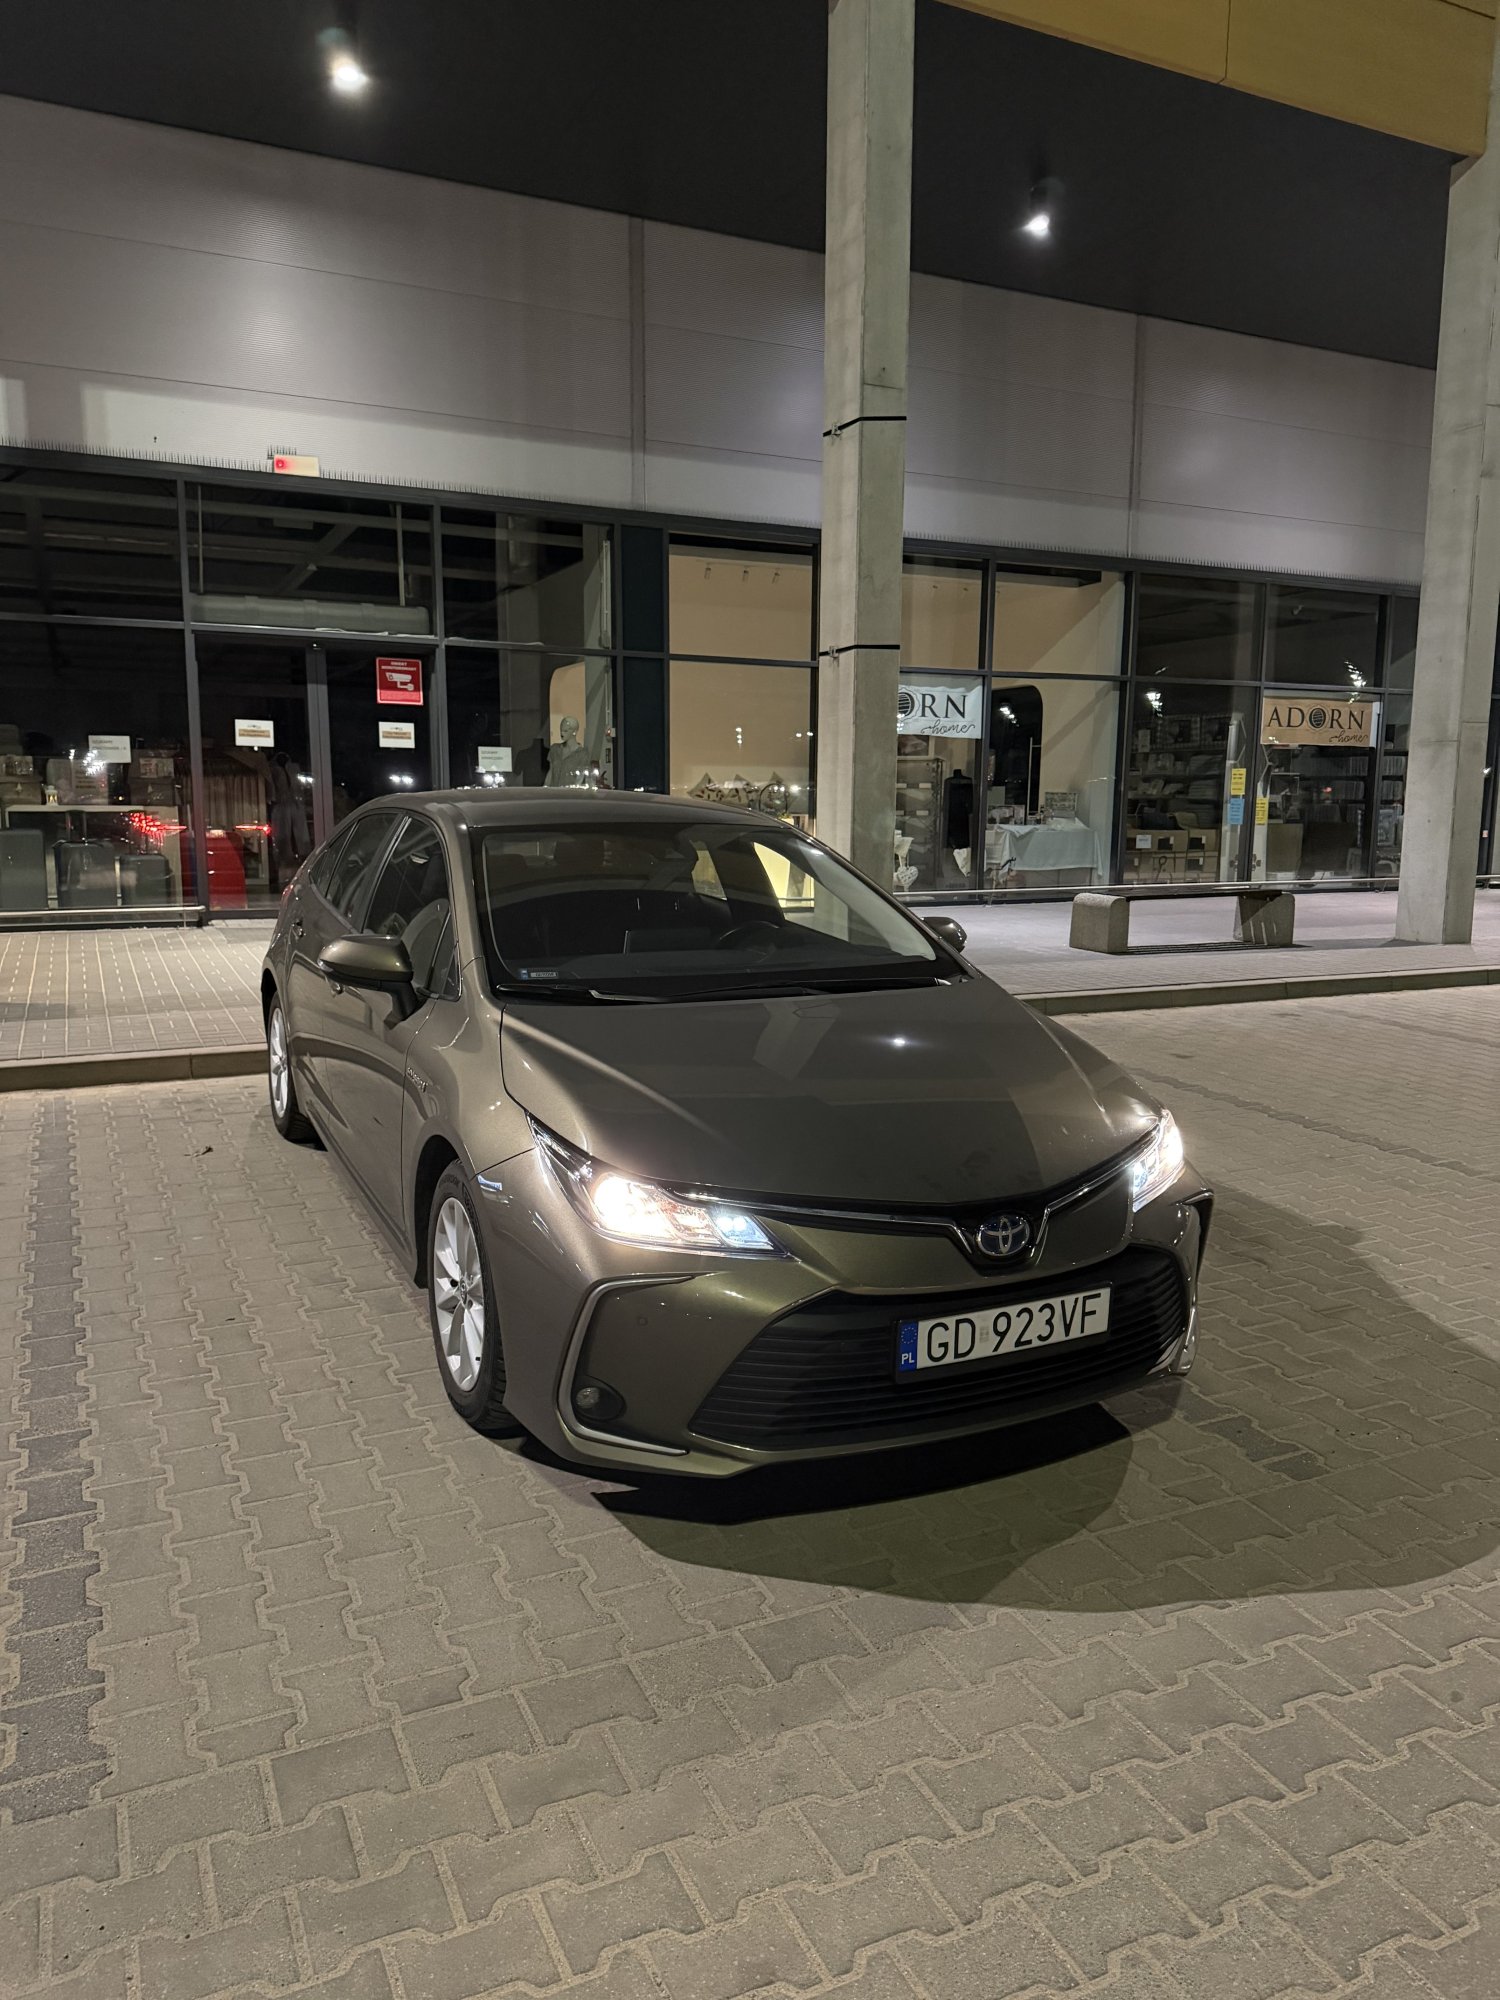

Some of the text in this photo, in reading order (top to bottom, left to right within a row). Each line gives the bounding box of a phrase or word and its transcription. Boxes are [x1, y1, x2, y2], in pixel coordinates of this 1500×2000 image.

[1266, 706, 1365, 730] ADORN
[921, 719, 976, 735] home
[1329, 730, 1368, 744] home
[926, 1292, 1102, 1363] GD 923VF
[901, 1352, 915, 1365] PL
